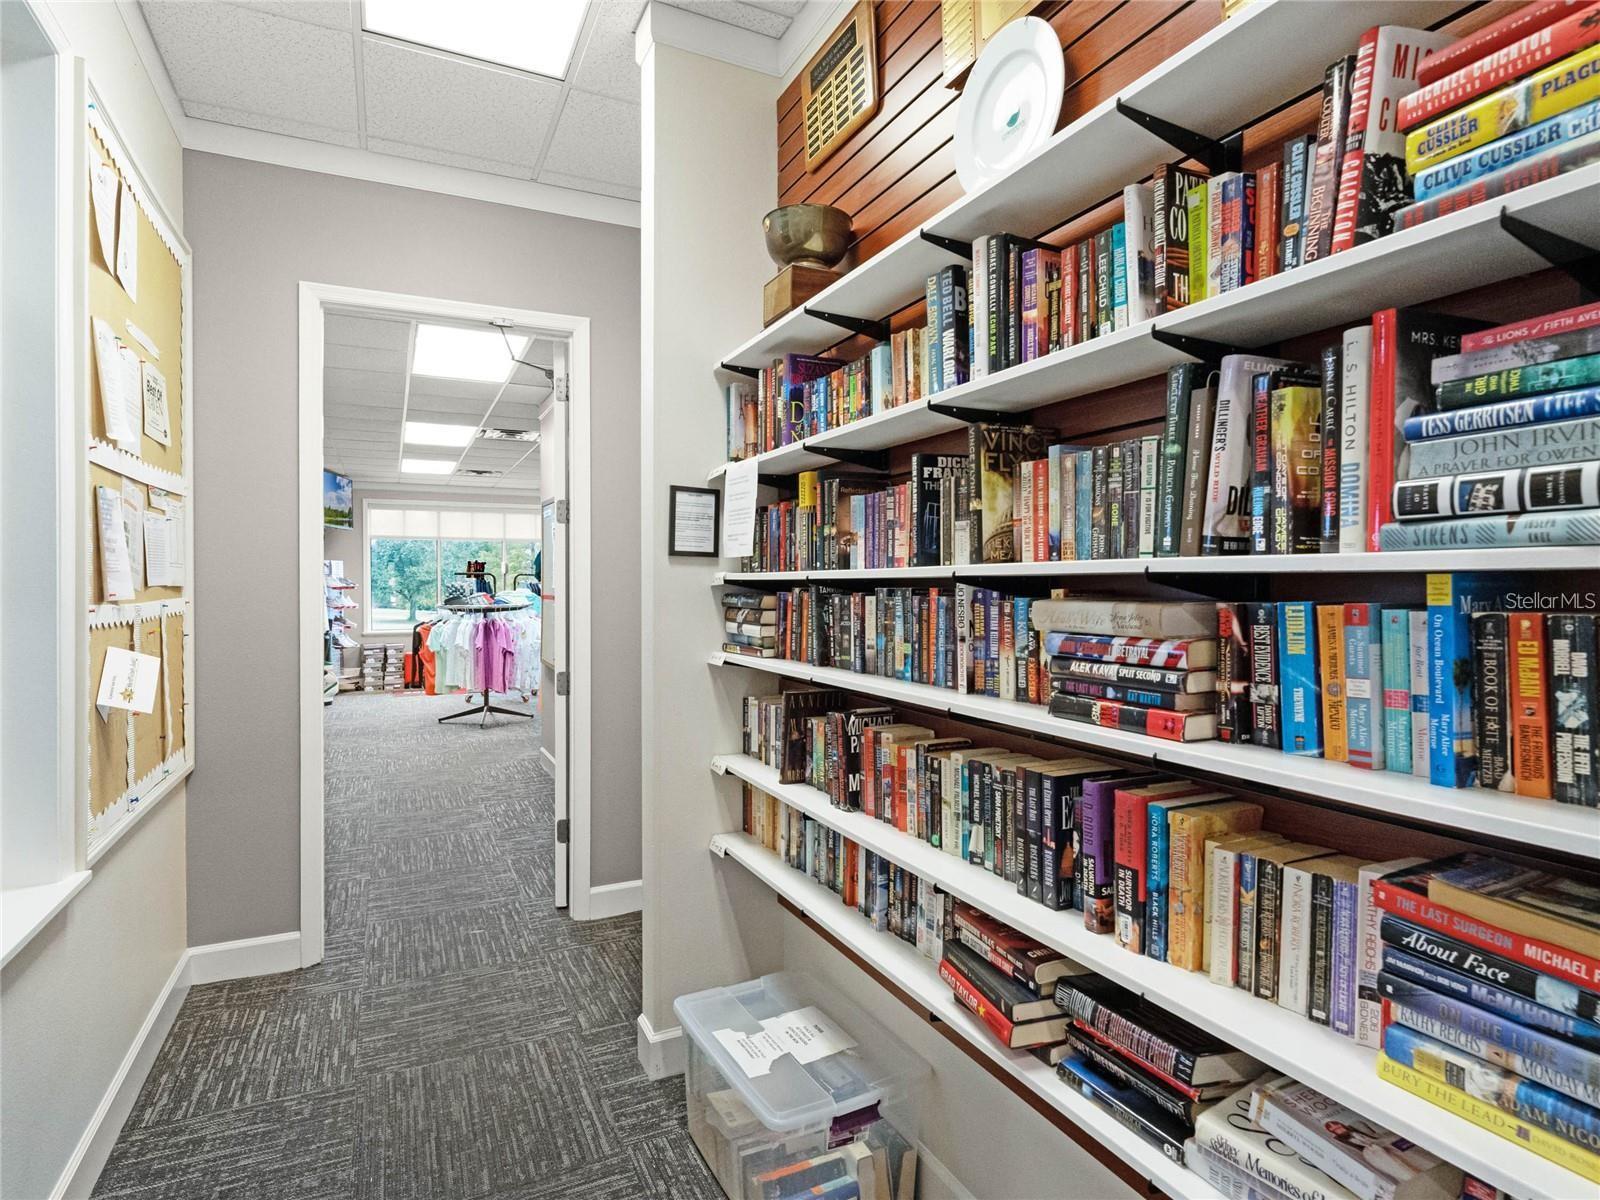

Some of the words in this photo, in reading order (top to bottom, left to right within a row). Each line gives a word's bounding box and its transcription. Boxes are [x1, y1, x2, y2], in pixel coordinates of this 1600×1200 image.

[1350, 42, 1374, 118] MICHAEL
[1406, 68, 1468, 110] MICHAEL
[1473, 31, 1552, 79] CRICHTON
[1320, 96, 1333, 140] COULTER
[1427, 113, 1468, 137] CLIVE
[1417, 117, 1479, 155] CUSSLER
[1292, 143, 1304, 173] CLIVE
[1423, 158, 1472, 190] CLIVE
[1478, 122, 1562, 168] CUSSLER
[1154, 180, 1165, 211] PATRICIA
[1289, 173, 1303, 220] CUSSLER
[1333, 160, 1360, 243] CRICHTON
[1155, 211, 1165, 249] CORNWELL
[1305, 185, 1326, 260] BEGINNING
[1320, 208, 1331, 230] THE
[1099, 253, 1107, 273] LEE
[1114, 247, 1125, 278] HARLAN
[1155, 264, 1165, 288] FRONT
[927, 276, 937, 304] DALE
[942, 270, 953, 295] TED
[1099, 275, 1107, 307] CHILD
[928, 305, 937, 345] BROWN
[942, 297, 952, 327] BELL
[1496, 327, 1528, 341] LIONS
[1544, 316, 1574, 331] FIFTH
[942, 328, 955, 383] WARLORD
[1346, 341, 1357, 357] L.
[1171, 373, 1179, 399] CIRCLE
[1346, 364, 1357, 379] S.
[1474, 375, 1488, 395] GIRL
[1489, 375, 1498, 391] WHO
[1509, 368, 1521, 392] TWICE
[1255, 390, 1268, 431] HEATHER
[1345, 385, 1357, 450] HILTON
[1421, 417, 1451, 437] TESS
[1455, 399, 1536, 432] GERRITSEN
[1168, 416, 1178, 441] THREE
[1255, 434, 1269, 472] GRAHAM
[1418, 465, 1428, 476] A
[1434, 458, 1489, 476] PRAYER
[1497, 452, 1529, 467] FOR
[1536, 444, 1597, 463] OWEN
[1453, 432, 1520, 459] JOHN
[1125, 452, 1133, 490] GRAFTON
[1165, 459, 1175, 493] PATRICIA
[1213, 453, 1221, 478] WILD
[1324, 448, 1336, 488] MISSION
[1252, 486, 1264, 516] KILLING
[1324, 491, 1336, 517] SONG
[1341, 462, 1360, 528] DOMINA
[1252, 516, 1264, 535] EDGE
[1412, 525, 1469, 545] SIRENS
[957, 585, 964, 597] JO
[1253, 625, 1270, 644] BEST
[1285, 605, 1306, 655] LUDLUM
[1433, 614, 1444, 627] On
[1348, 638, 1357, 665] Guests
[1356, 641, 1365, 674] Summer
[1434, 630, 1444, 657] Ocean
[1517, 641, 1538, 654] ED
[1552, 639, 1570, 676] MORRELL
[1028, 657, 1036, 698] EXPOSED
[1070, 661, 1091, 673] ALEX
[1118, 668, 1135, 678] SPLIT
[1254, 646, 1272, 682] EVIDENCE
[1484, 659, 1497, 692] BOOK
[1518, 657, 1541, 697] McBAIN
[1571, 652, 1587, 677] DAVID
[1434, 660, 1445, 704] Boulevard
[1264, 705, 1272, 725] DAVID
[1293, 687, 1305, 723] TREVAYNE
[1328, 699, 1343, 730] Mexico
[1358, 703, 1367, 726] Mary
[1485, 696, 1498, 712] OF
[1350, 709, 1359, 739] Monroe
[1360, 726, 1368, 747] Alice
[1430, 718, 1439, 749] Monroe
[1440, 713, 1450, 736] Mary
[1486, 716, 1500, 744] FATE
[1533, 725, 1543, 740] THE
[1442, 737, 1450, 757] Alice
[1519, 725, 1532, 781] BANDERSNATCH
[1556, 732, 1573, 783] PROFESSION
[1574, 735, 1590, 750] THE
[1482, 748, 1493, 785] MELTZER
[1493, 756, 1504, 779] BRAD
[1533, 741, 1544, 779] FRUMIOUS
[1574, 752, 1590, 775] FIFTH
[1151, 812, 1159, 838] NORA
[1016, 837, 1024, 872] ROSENBERG
[1030, 844, 1038, 880] ROSENBERG
[1044, 850, 1053, 886] ROSENBERG
[1151, 840, 1159, 880] ROBERTS
[1118, 868, 1125, 879] IN
[1117, 880, 1125, 907] DEATH
[1365, 933, 1377, 970] REICHS
[1395, 895, 1417, 913] THE
[1420, 905, 1450, 926] LAST
[1453, 918, 1513, 949] SURGEON
[1523, 944, 1589, 980] MICHAEL
[1401, 932, 1459, 962] About
[1463, 952, 1511, 984] Face
[940, 967, 956, 987] BRAD
[956, 980, 978, 1008] TAYLOR
[1360, 1001, 1369, 1040] BONES
[1371, 1008, 1379, 1032] 206
[1401, 1008, 1436, 1035] KATHY
[1439, 1022, 1482, 1058] REICHS
[1520, 1058, 1581, 1095] MONDAY
[1383, 1062, 1421, 1088] BURY
[1425, 1079, 1457, 1104] THE
[1461, 1099, 1507, 1130] LEAD
[1245, 1152, 1302, 1196] Memories
